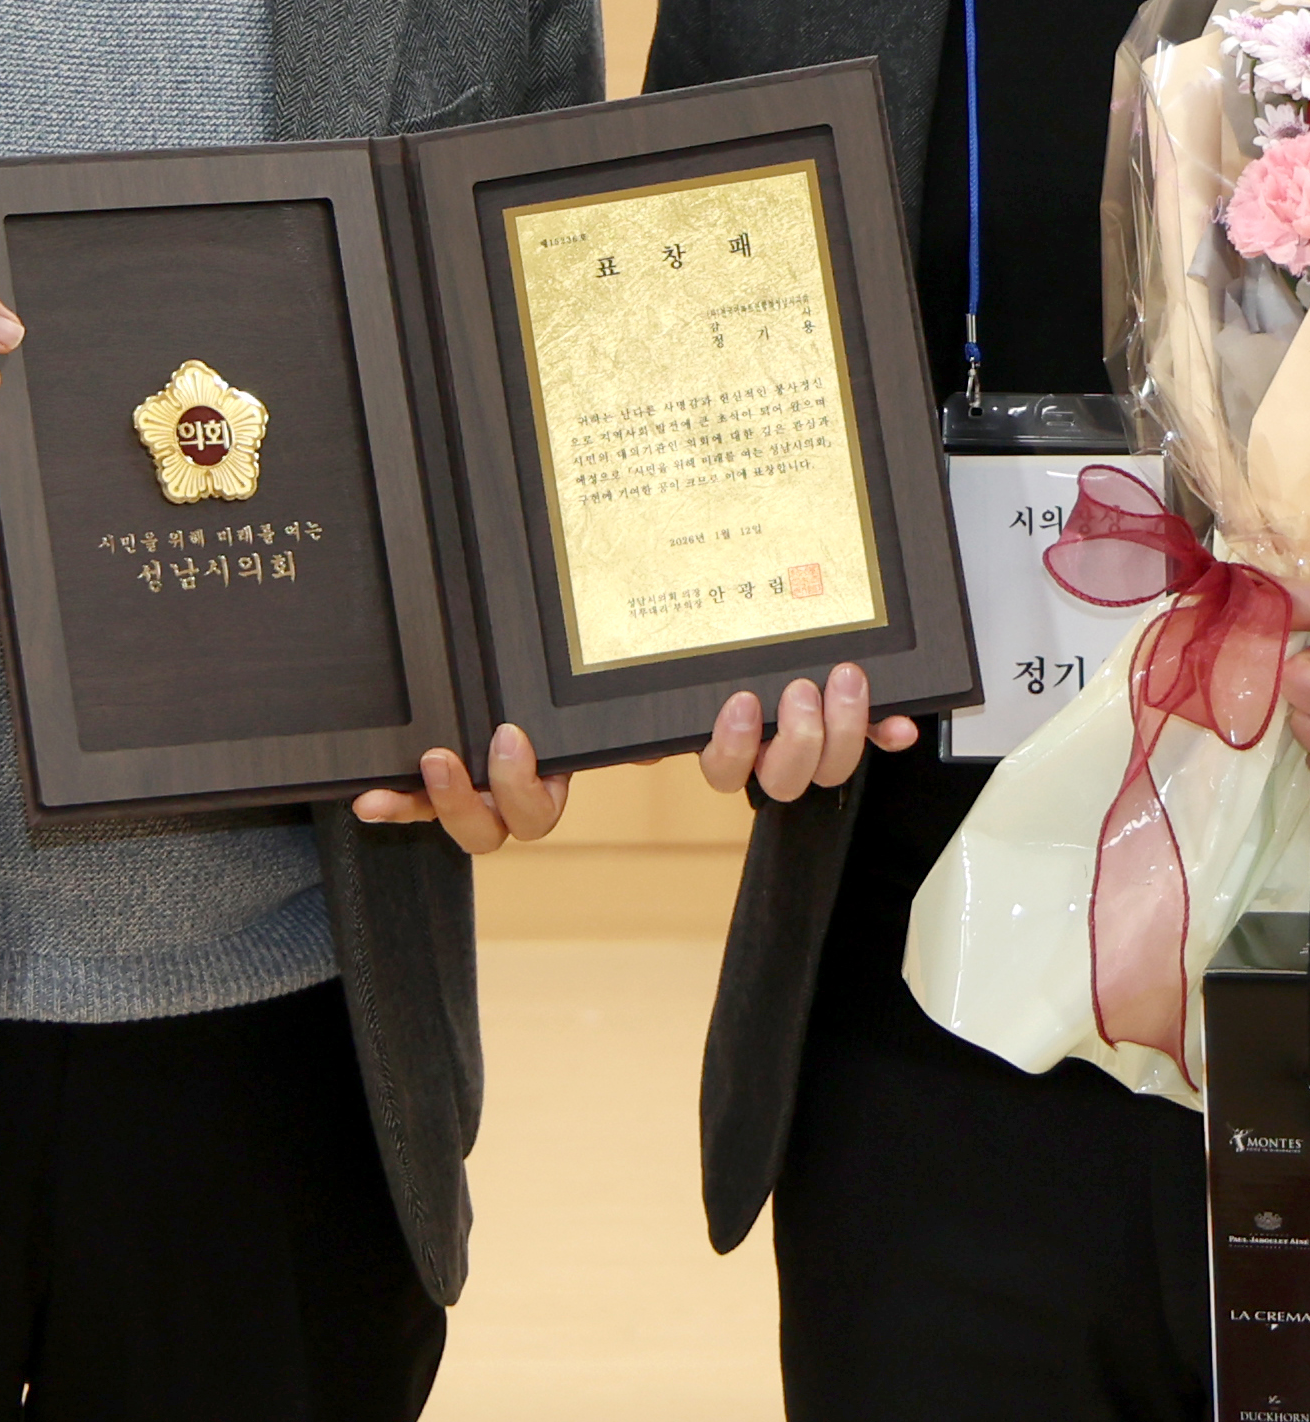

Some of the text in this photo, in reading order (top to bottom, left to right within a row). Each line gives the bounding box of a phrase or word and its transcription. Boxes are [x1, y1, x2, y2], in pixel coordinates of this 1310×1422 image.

[578, 377, 822, 426] 귀하는 남다른 사명감과 헌신적인 봉사정신
[177, 419, 230, 451] 의회
[571, 397, 826, 447] 으로 지역사회 발전에 큰 초석이 되어 왔으며
[574, 451, 608, 466] 시민의
[686, 433, 722, 448] 의회에
[730, 428, 753, 442] 대한
[761, 424, 786, 438] 깊은
[793, 416, 829, 431] 관심과
[576, 470, 620, 485] 애정으로
[674, 457, 696, 471] 위해
[701, 451, 734, 466] 미래를
[741, 447, 763, 459] 여는
[579, 489, 613, 506] 구현에
[619, 485, 652, 499] 기여한
[659, 479, 680, 493] 공이
[685, 474, 720, 488] 크므로
[725, 468, 747, 481] 이에
[98, 520, 323, 555] 시민을 위해 미래를 여는
[669, 524, 762, 548] 2026년 1월 12일
[137, 550, 296, 593] 성남시의회
[627, 588, 701, 609] 성남시의회 의장
[673, 598, 703, 612] 부의장
[1012, 655, 1107, 695] 정기
[1247, 1137, 1302, 1149] MONTES
[1230, 1309, 1251, 1321] LA
[1240, 1411, 1310, 1422] DUCKHORN
